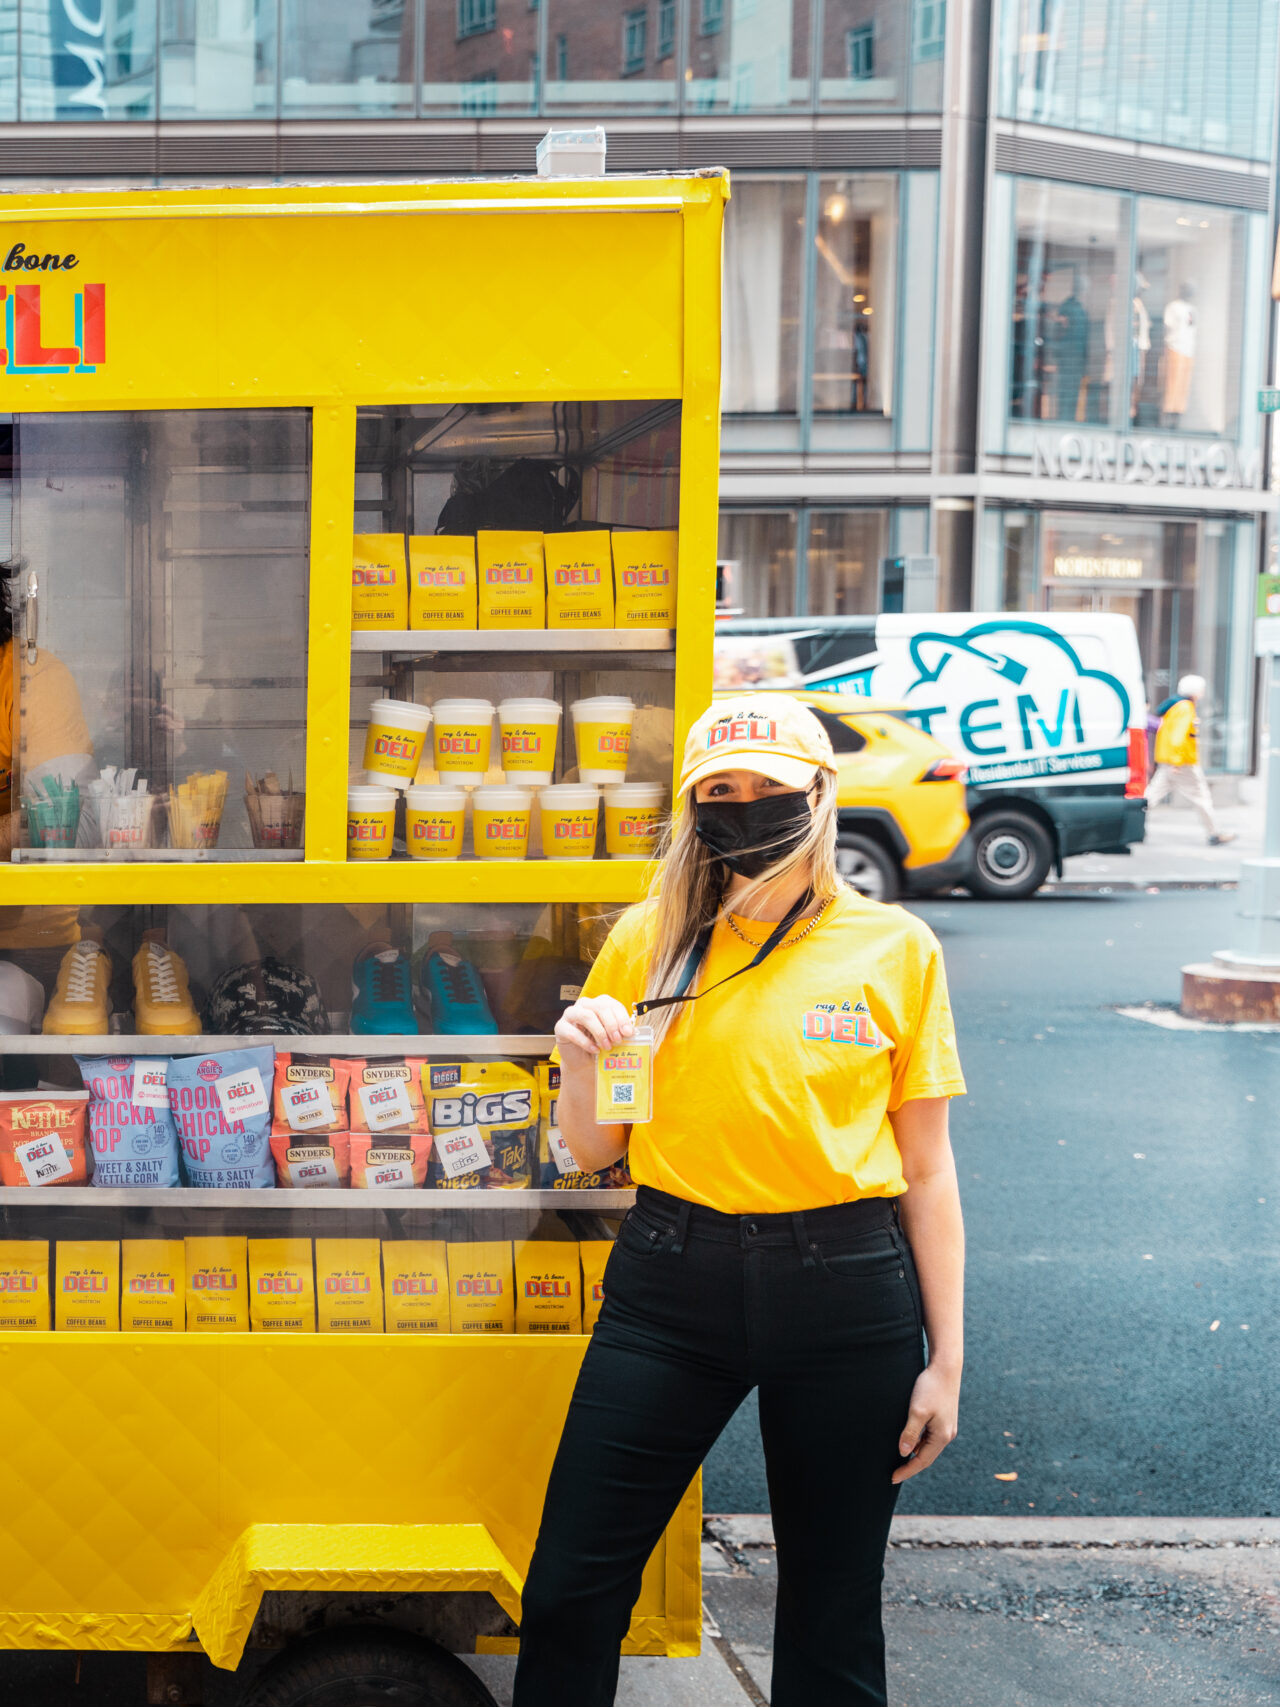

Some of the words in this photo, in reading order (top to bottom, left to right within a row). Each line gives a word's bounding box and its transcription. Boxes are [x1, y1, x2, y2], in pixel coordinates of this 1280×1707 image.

[2, 243, 79, 272] bone
[1033, 434, 1258, 489] NORDSTROM
[352, 569, 396, 586] DELI
[418, 571, 466, 586] DELI
[486, 567, 533, 585] DELI
[555, 568, 601, 585] DELI
[622, 569, 669, 587] DELI
[707, 721, 776, 749] DELI
[374, 739, 417, 760] DELI
[439, 738, 481, 754] DELI
[502, 737, 541, 753] DELI
[110, 828, 143, 842] DELI
[348, 824, 386, 841] DELI
[413, 824, 456, 841] DELI
[486, 823, 527, 840] DELI
[815, 1004, 836, 1013] rag
[841, 1000, 850, 1011] &
[196, 1066, 223, 1075] ANGIE'S
[604, 1057, 642, 1071] DELI
[143, 1074, 167, 1086] DEL
[290, 1068, 331, 1078] SNYDER'S
[366, 1069, 408, 1079] SNYDER'S
[227, 1084, 256, 1100] DELI
[291, 1090, 319, 1106] DELI
[369, 1089, 397, 1105] DELI
[10, 1102, 76, 1130] KETTLE
[27, 1144, 54, 1162] DELI
[290, 1149, 331, 1157] SNYDER'S
[445, 1137, 474, 1153] DELI
[370, 1151, 411, 1161] SNYDER'S
[126, 1163, 132, 1172] &
[136, 1160, 163, 1173] SALTY
[298, 1166, 327, 1178] DELI
[134, 1173, 159, 1183] CORN
[217, 1171, 223, 1181] &
[226, 1169, 255, 1181] SALTY
[375, 1171, 403, 1184] DELI
[63, 1276, 108, 1292] DELI
[129, 1278, 174, 1294] DELI
[192, 1273, 237, 1291] DELI
[258, 1277, 303, 1294] DELI
[325, 1277, 371, 1294] DELI
[392, 1278, 438, 1296] DELI
[457, 1279, 503, 1296] DELI
[525, 1280, 571, 1298] DELI
